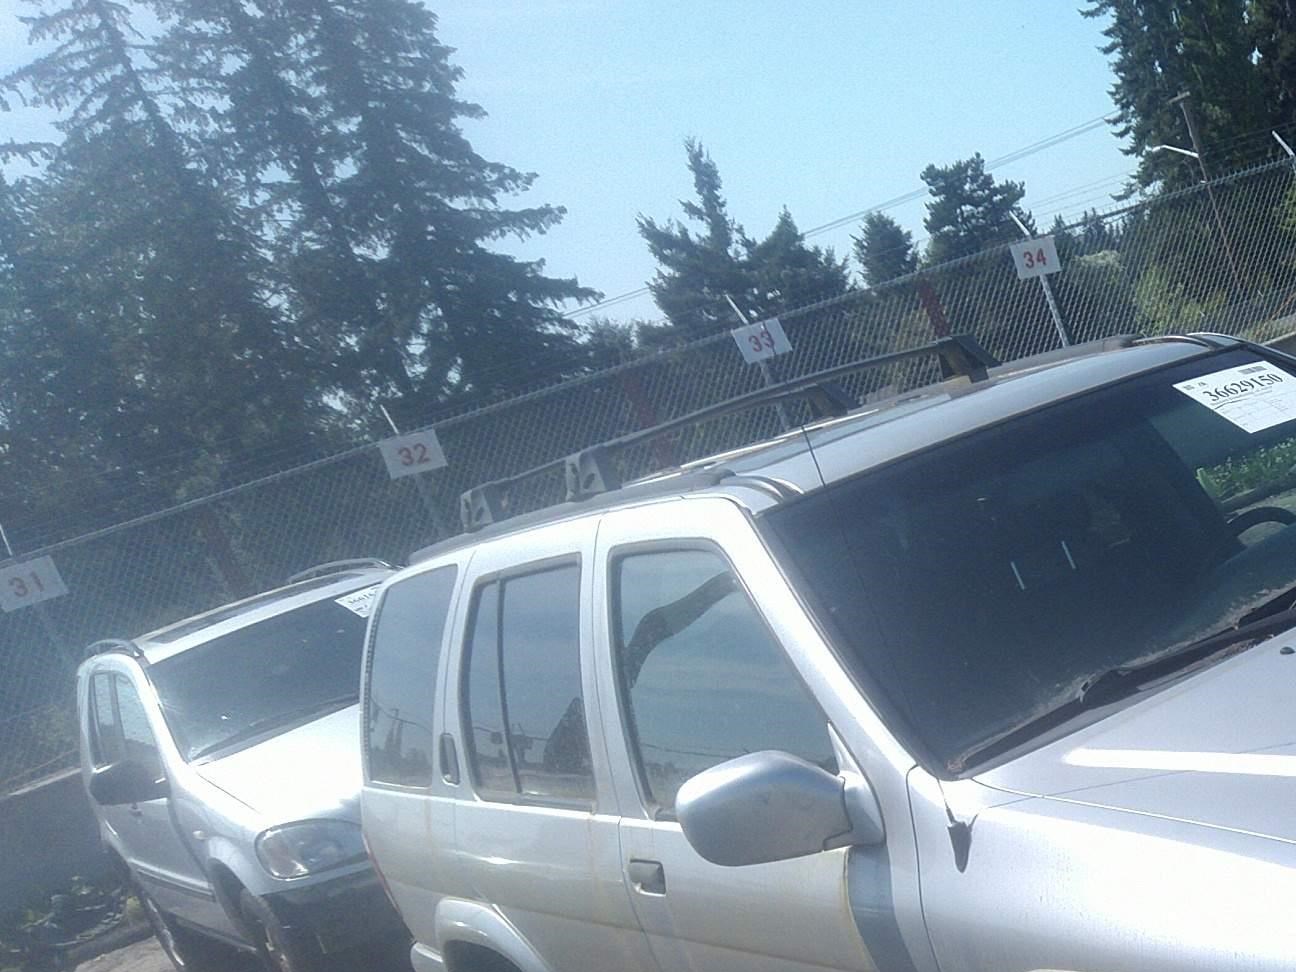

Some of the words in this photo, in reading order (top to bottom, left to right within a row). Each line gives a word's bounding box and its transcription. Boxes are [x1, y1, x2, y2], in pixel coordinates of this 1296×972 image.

[1023, 247, 1047, 269] 34
[748, 330, 775, 353] 33
[1202, 372, 1284, 402] 36629150
[398, 442, 430, 467] 32
[9, 570, 45, 597] 31
